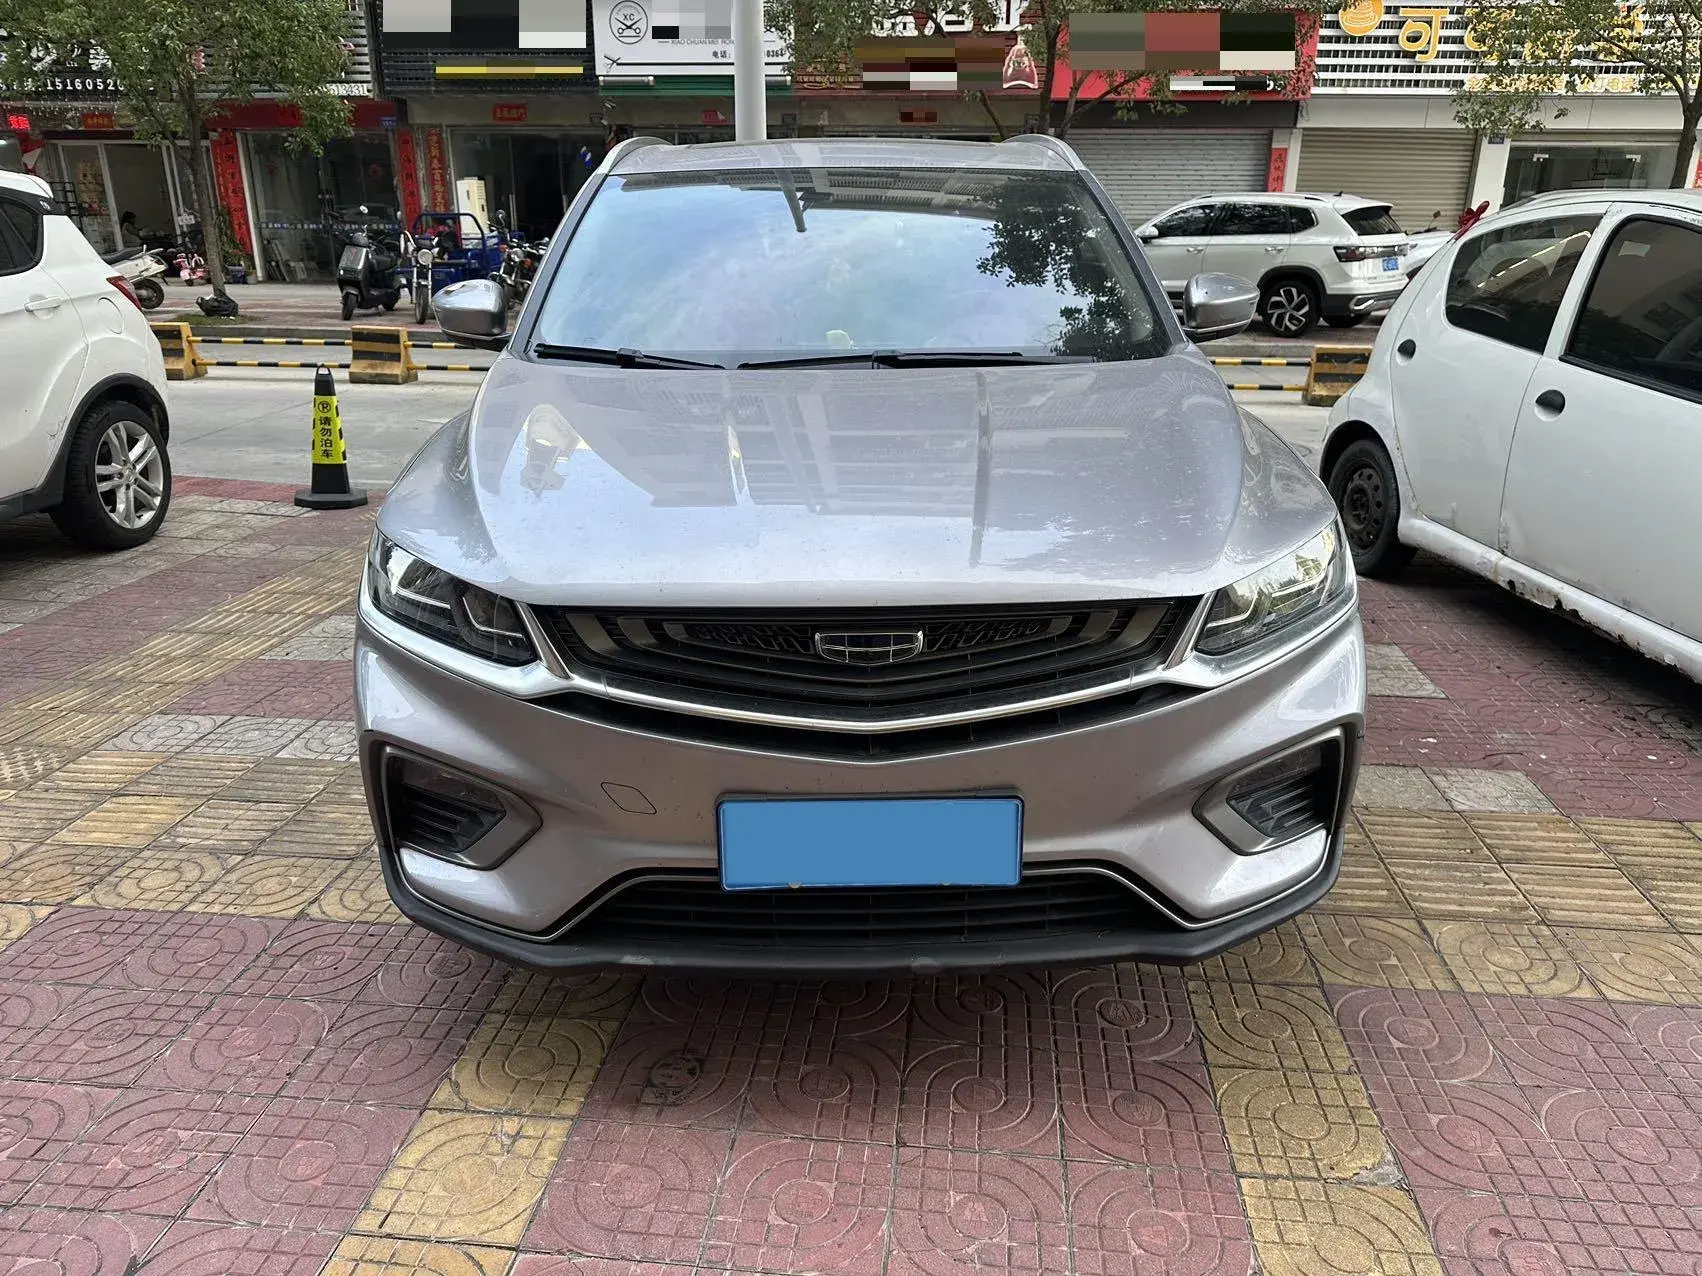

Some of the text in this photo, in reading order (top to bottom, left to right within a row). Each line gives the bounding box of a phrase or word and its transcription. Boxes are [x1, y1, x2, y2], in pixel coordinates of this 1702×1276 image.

[622, 13, 635, 22] XC
[319, 416, 333, 458] 请勿泊车
